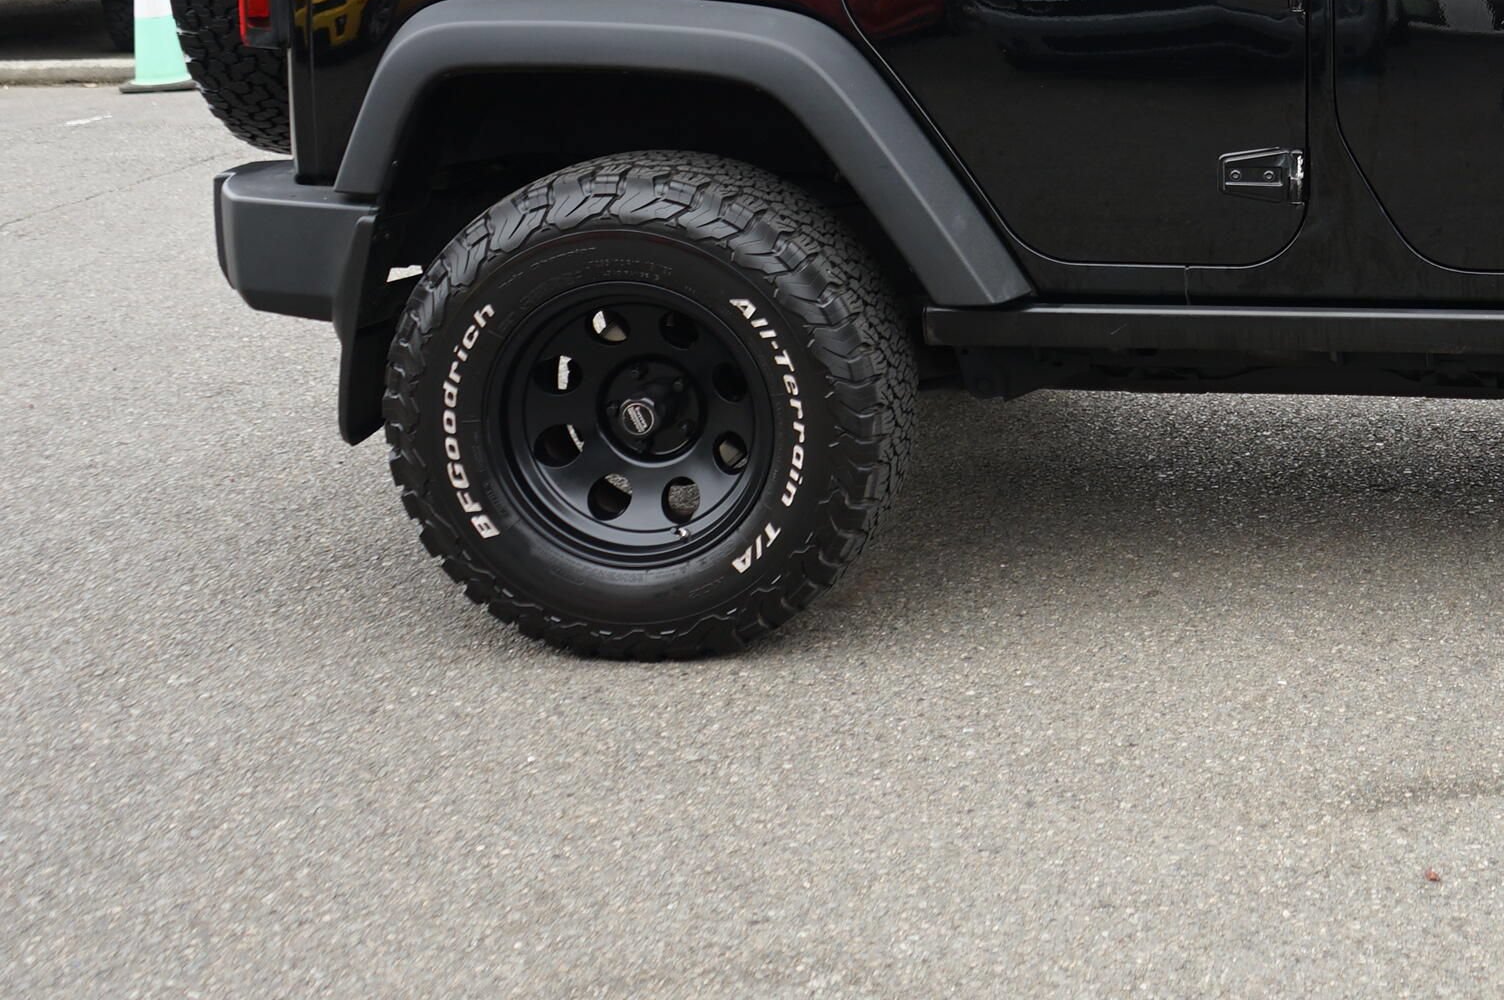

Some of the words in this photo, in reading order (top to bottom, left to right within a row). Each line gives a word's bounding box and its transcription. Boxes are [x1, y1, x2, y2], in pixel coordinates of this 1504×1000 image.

[440, 303, 500, 540] BFGoodrich
[729, 297, 806, 507] All-Terrain
[731, 521, 782, 575] T/A
